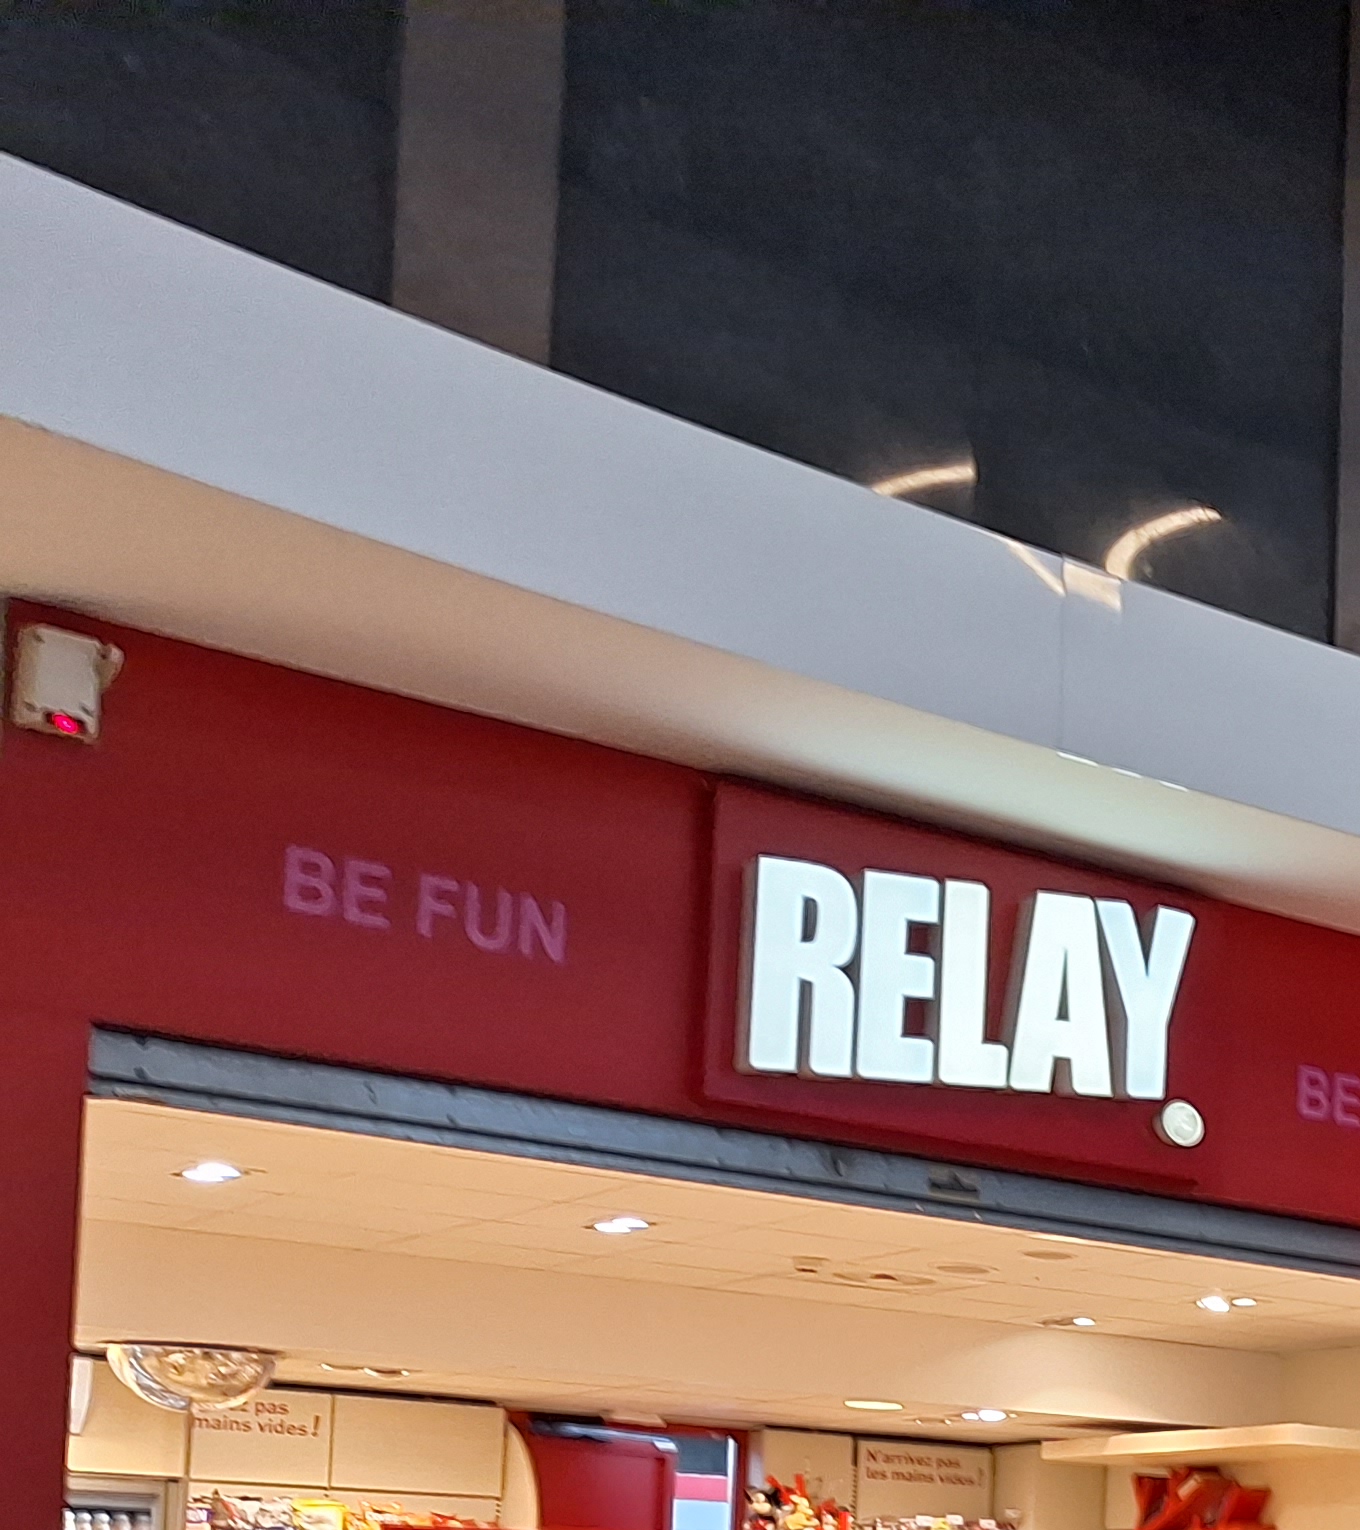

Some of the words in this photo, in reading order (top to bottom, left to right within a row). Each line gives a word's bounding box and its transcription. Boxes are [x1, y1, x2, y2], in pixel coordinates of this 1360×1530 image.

[283, 844, 392, 931] BE
[416, 872, 568, 964] FUN
[254, 1400, 290, 1416] pas
[193, 1414, 252, 1433] mains
